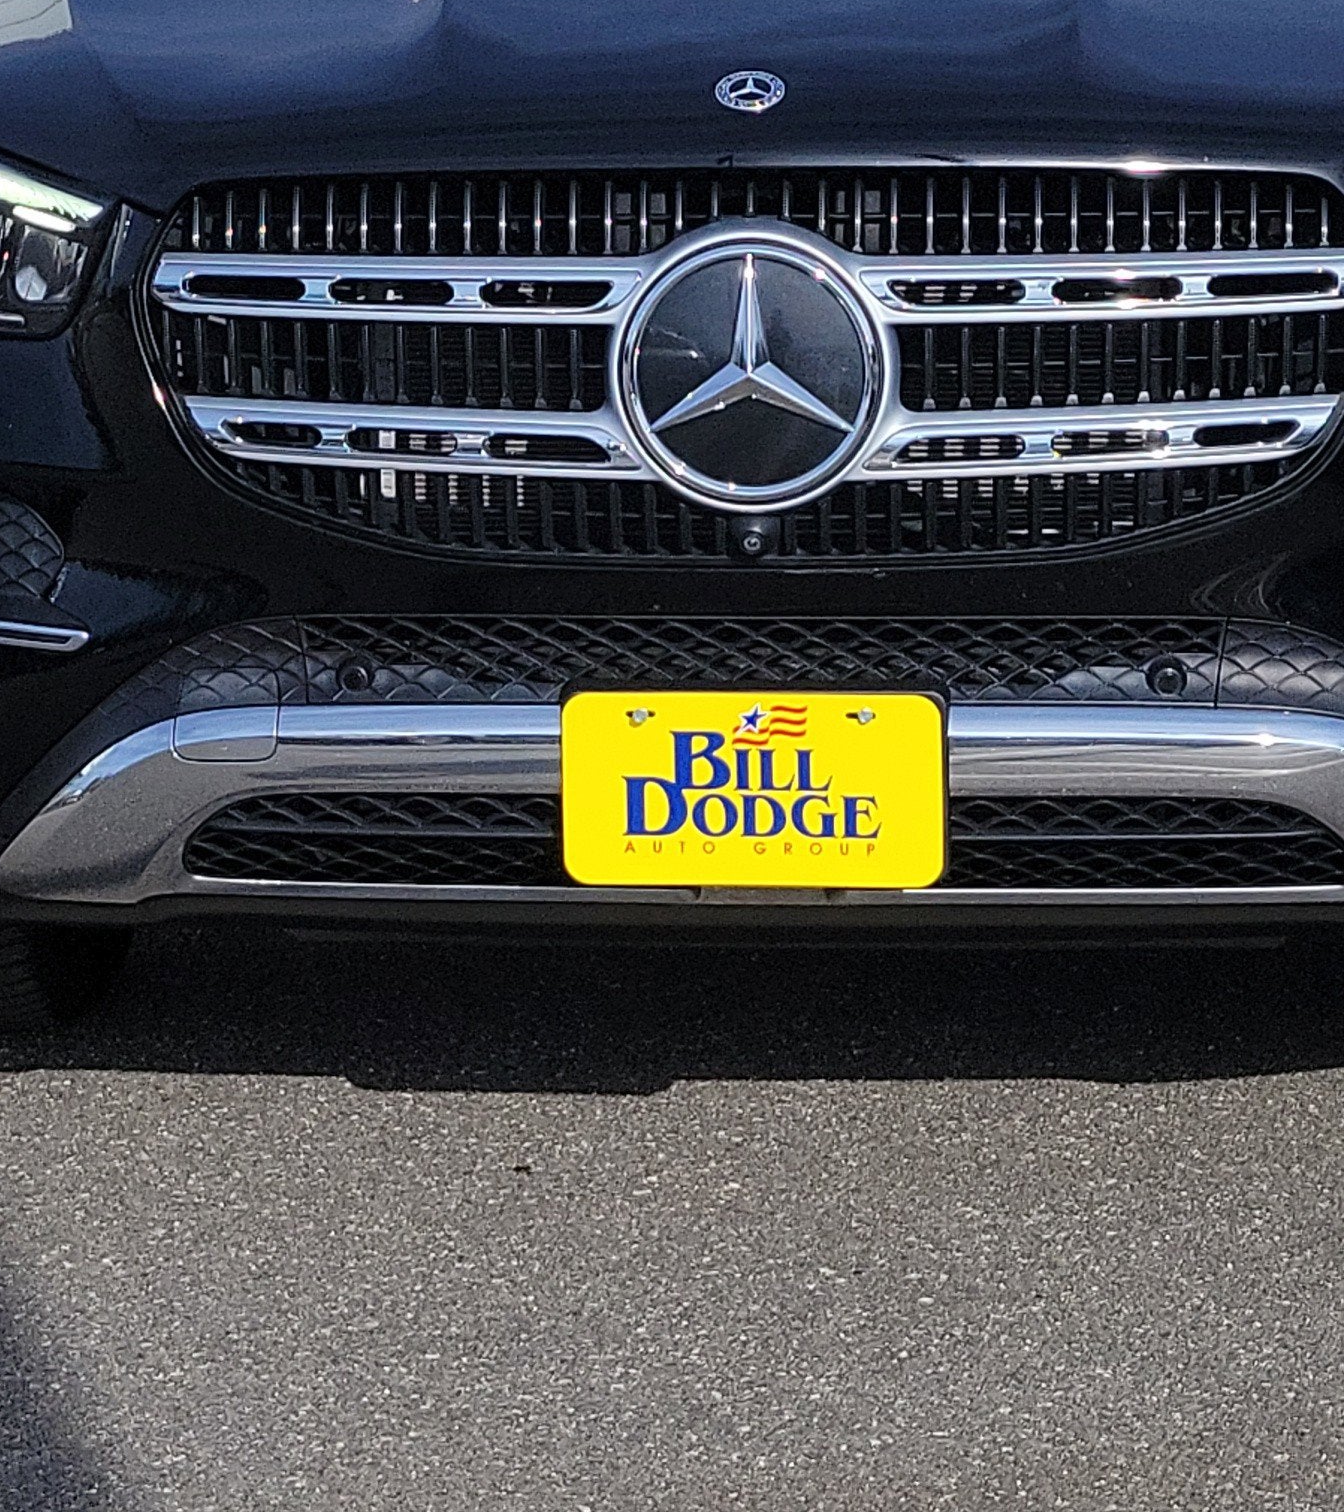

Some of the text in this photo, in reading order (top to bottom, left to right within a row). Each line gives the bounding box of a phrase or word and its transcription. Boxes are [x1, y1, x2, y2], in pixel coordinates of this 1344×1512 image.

[669, 730, 833, 792] BILL
[621, 775, 882, 840] DODGE
[624, 840, 877, 858] AUTO GROUP
